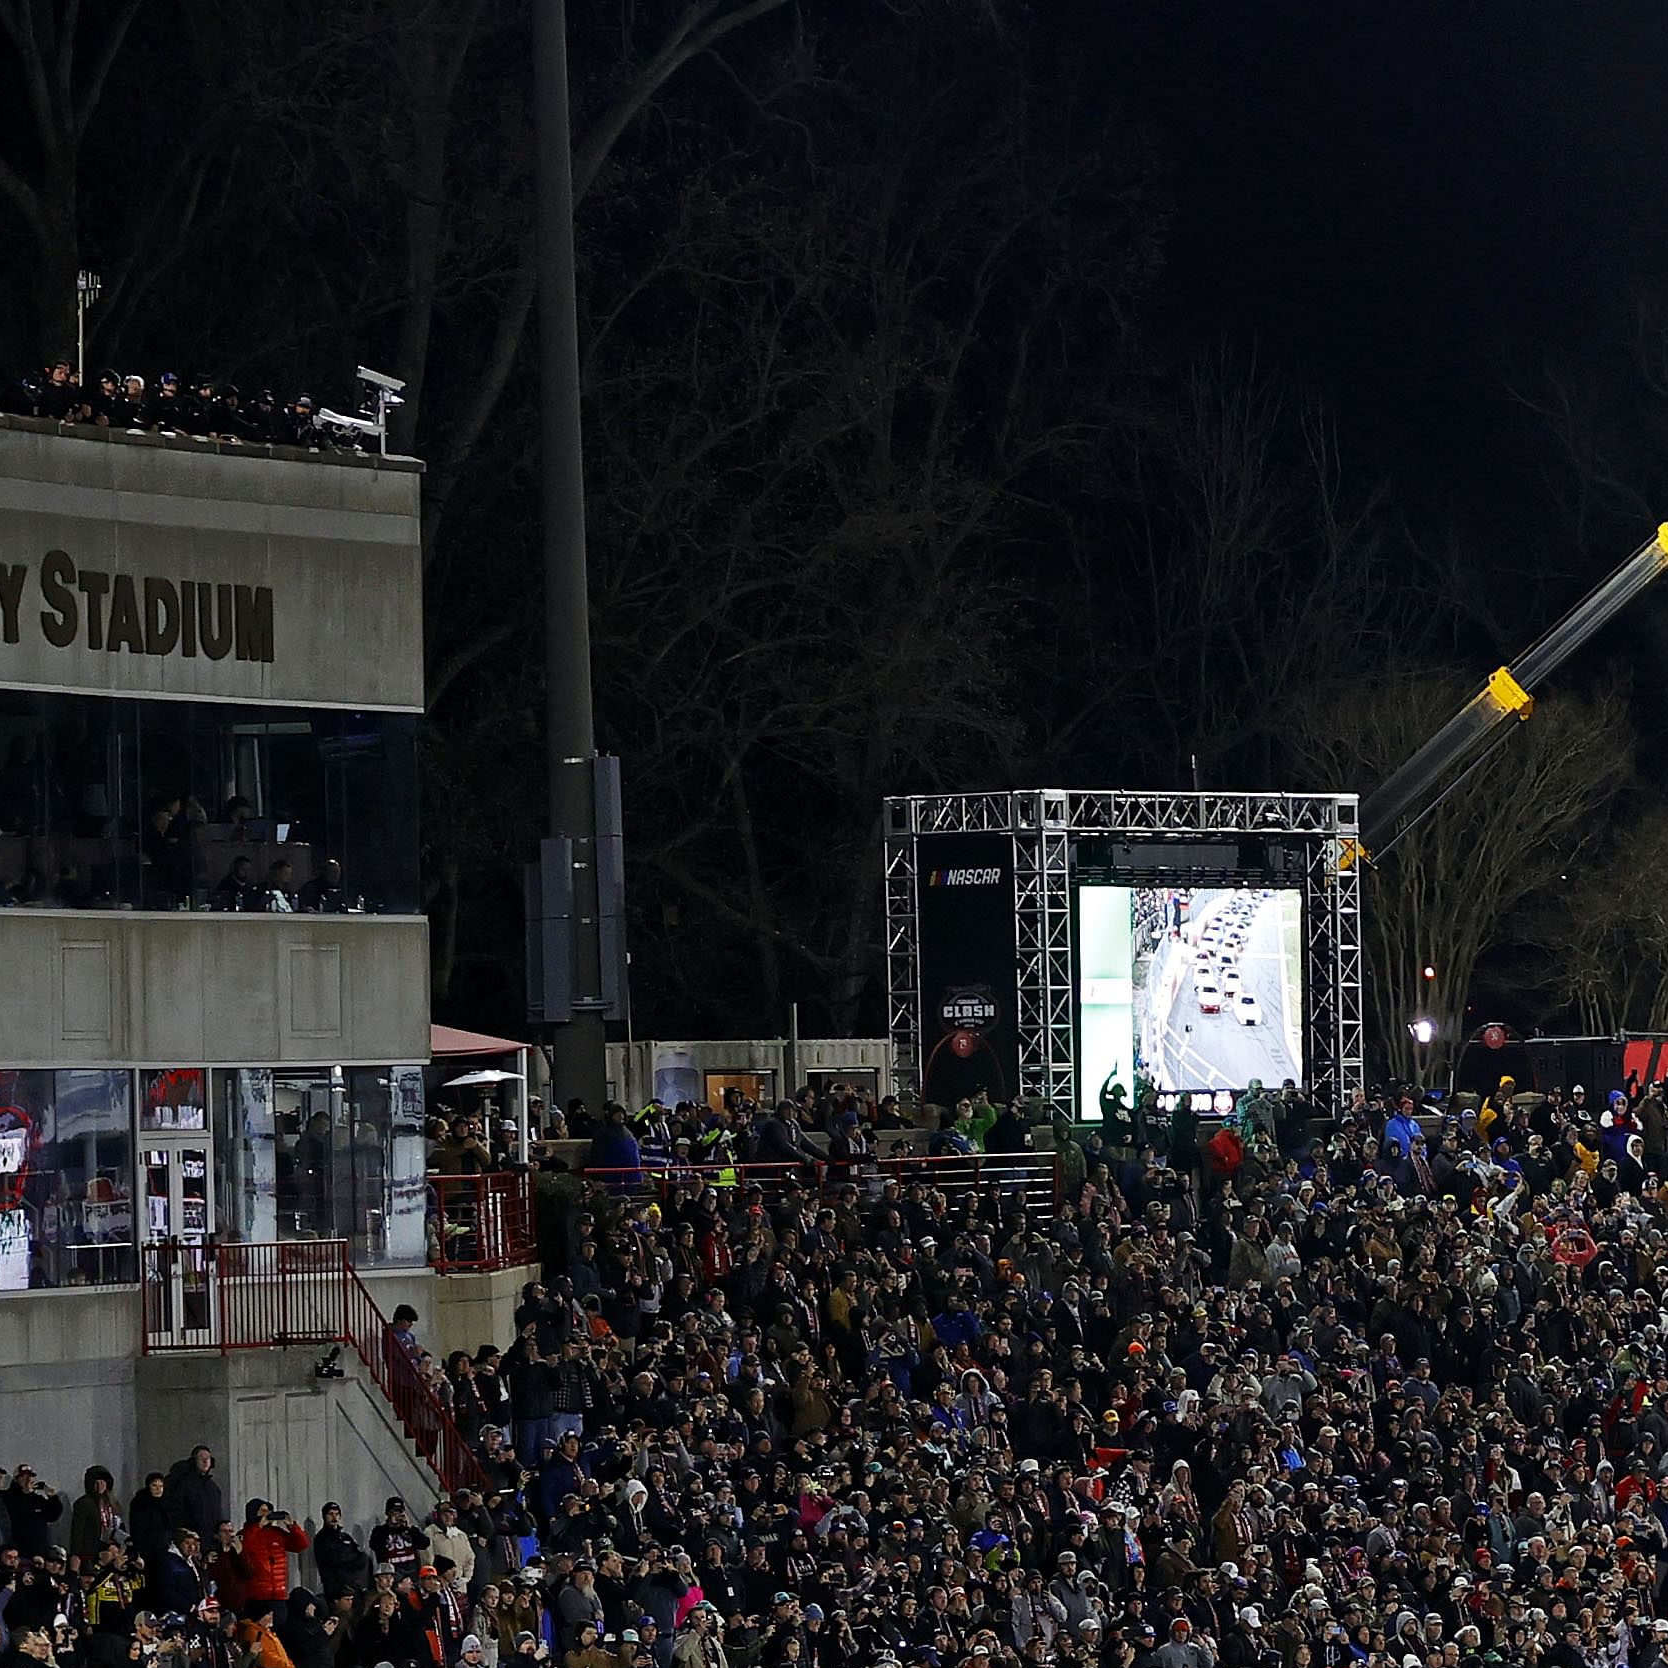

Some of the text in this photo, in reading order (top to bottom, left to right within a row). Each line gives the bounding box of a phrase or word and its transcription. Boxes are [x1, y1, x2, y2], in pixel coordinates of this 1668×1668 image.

[40, 548, 274, 663] STADIUM
[946, 868, 1001, 885] NASCAR
[943, 1005, 995, 1018] CLASH
